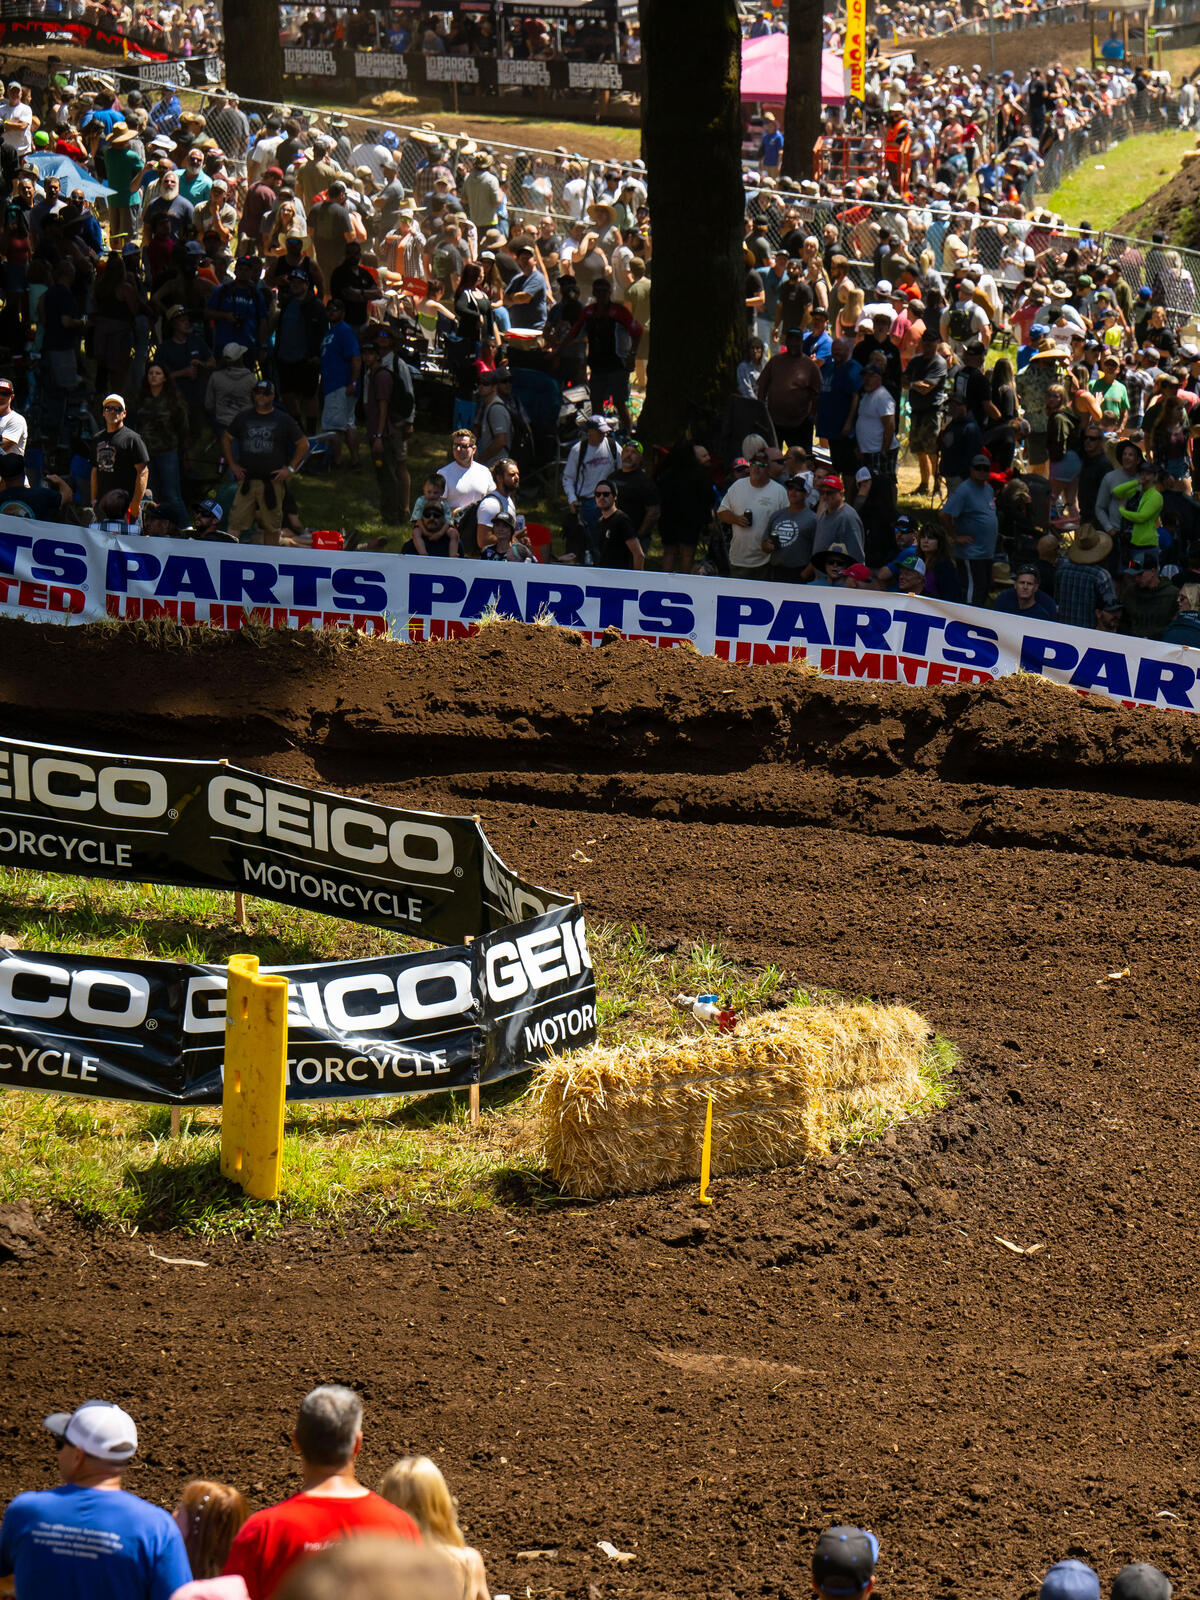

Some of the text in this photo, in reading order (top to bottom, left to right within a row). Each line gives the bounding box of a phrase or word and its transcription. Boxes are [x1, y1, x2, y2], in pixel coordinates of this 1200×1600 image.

[296, 49, 336, 65] BARREL
[366, 53, 407, 69] BARREL
[438, 56, 476, 72] BARREL
[106, 549, 388, 612] PARTS
[408, 572, 695, 635] PARTS
[106, 594, 389, 638] UNLIMITED
[715, 595, 999, 669] PARTS
[0, 751, 168, 818] ICO
[208, 774, 455, 875] GEICO
[242, 858, 423, 923] MOTORCYCLE
[524, 1004, 597, 1053] MOTOR
[220, 1048, 451, 1085] TORCYCLE
